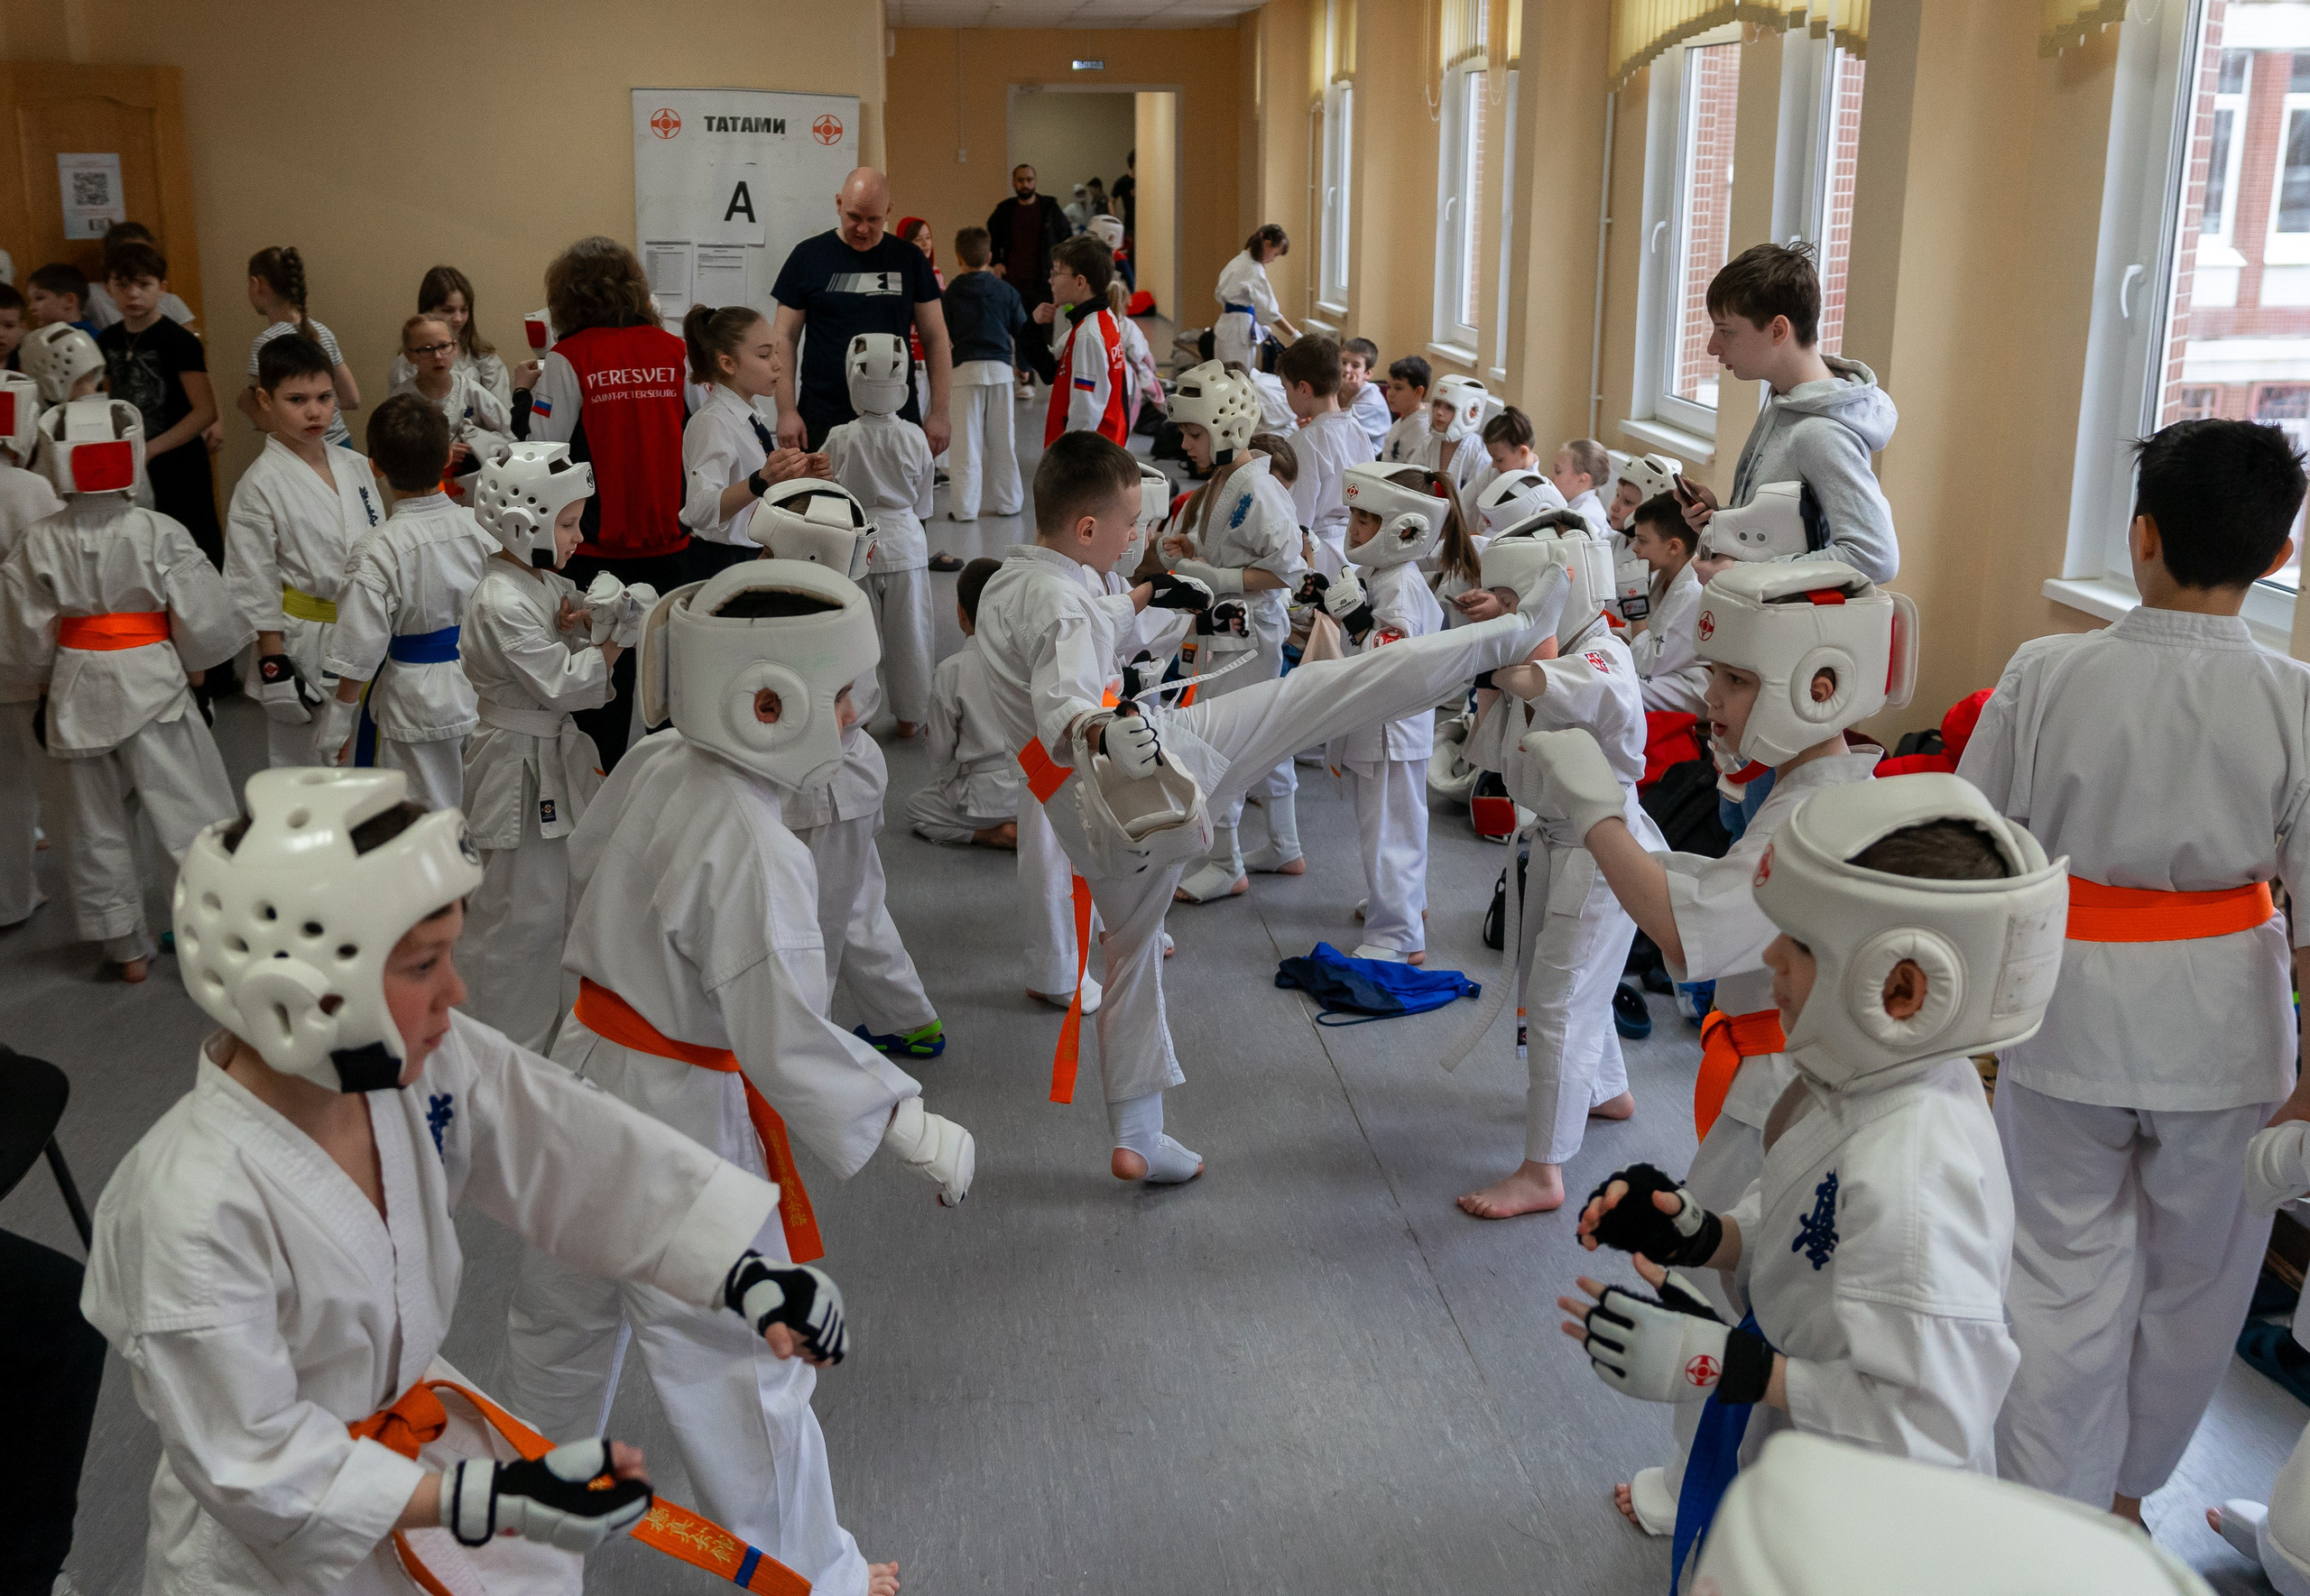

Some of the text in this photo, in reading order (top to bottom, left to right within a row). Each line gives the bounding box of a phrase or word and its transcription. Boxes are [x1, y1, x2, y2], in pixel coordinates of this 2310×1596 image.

[704, 115, 786, 134] ТАТАМИ
[724, 180, 756, 223] А
[587, 367, 676, 389] PERESVET
[591, 389, 677, 404] SAINT-PETERSBURG
